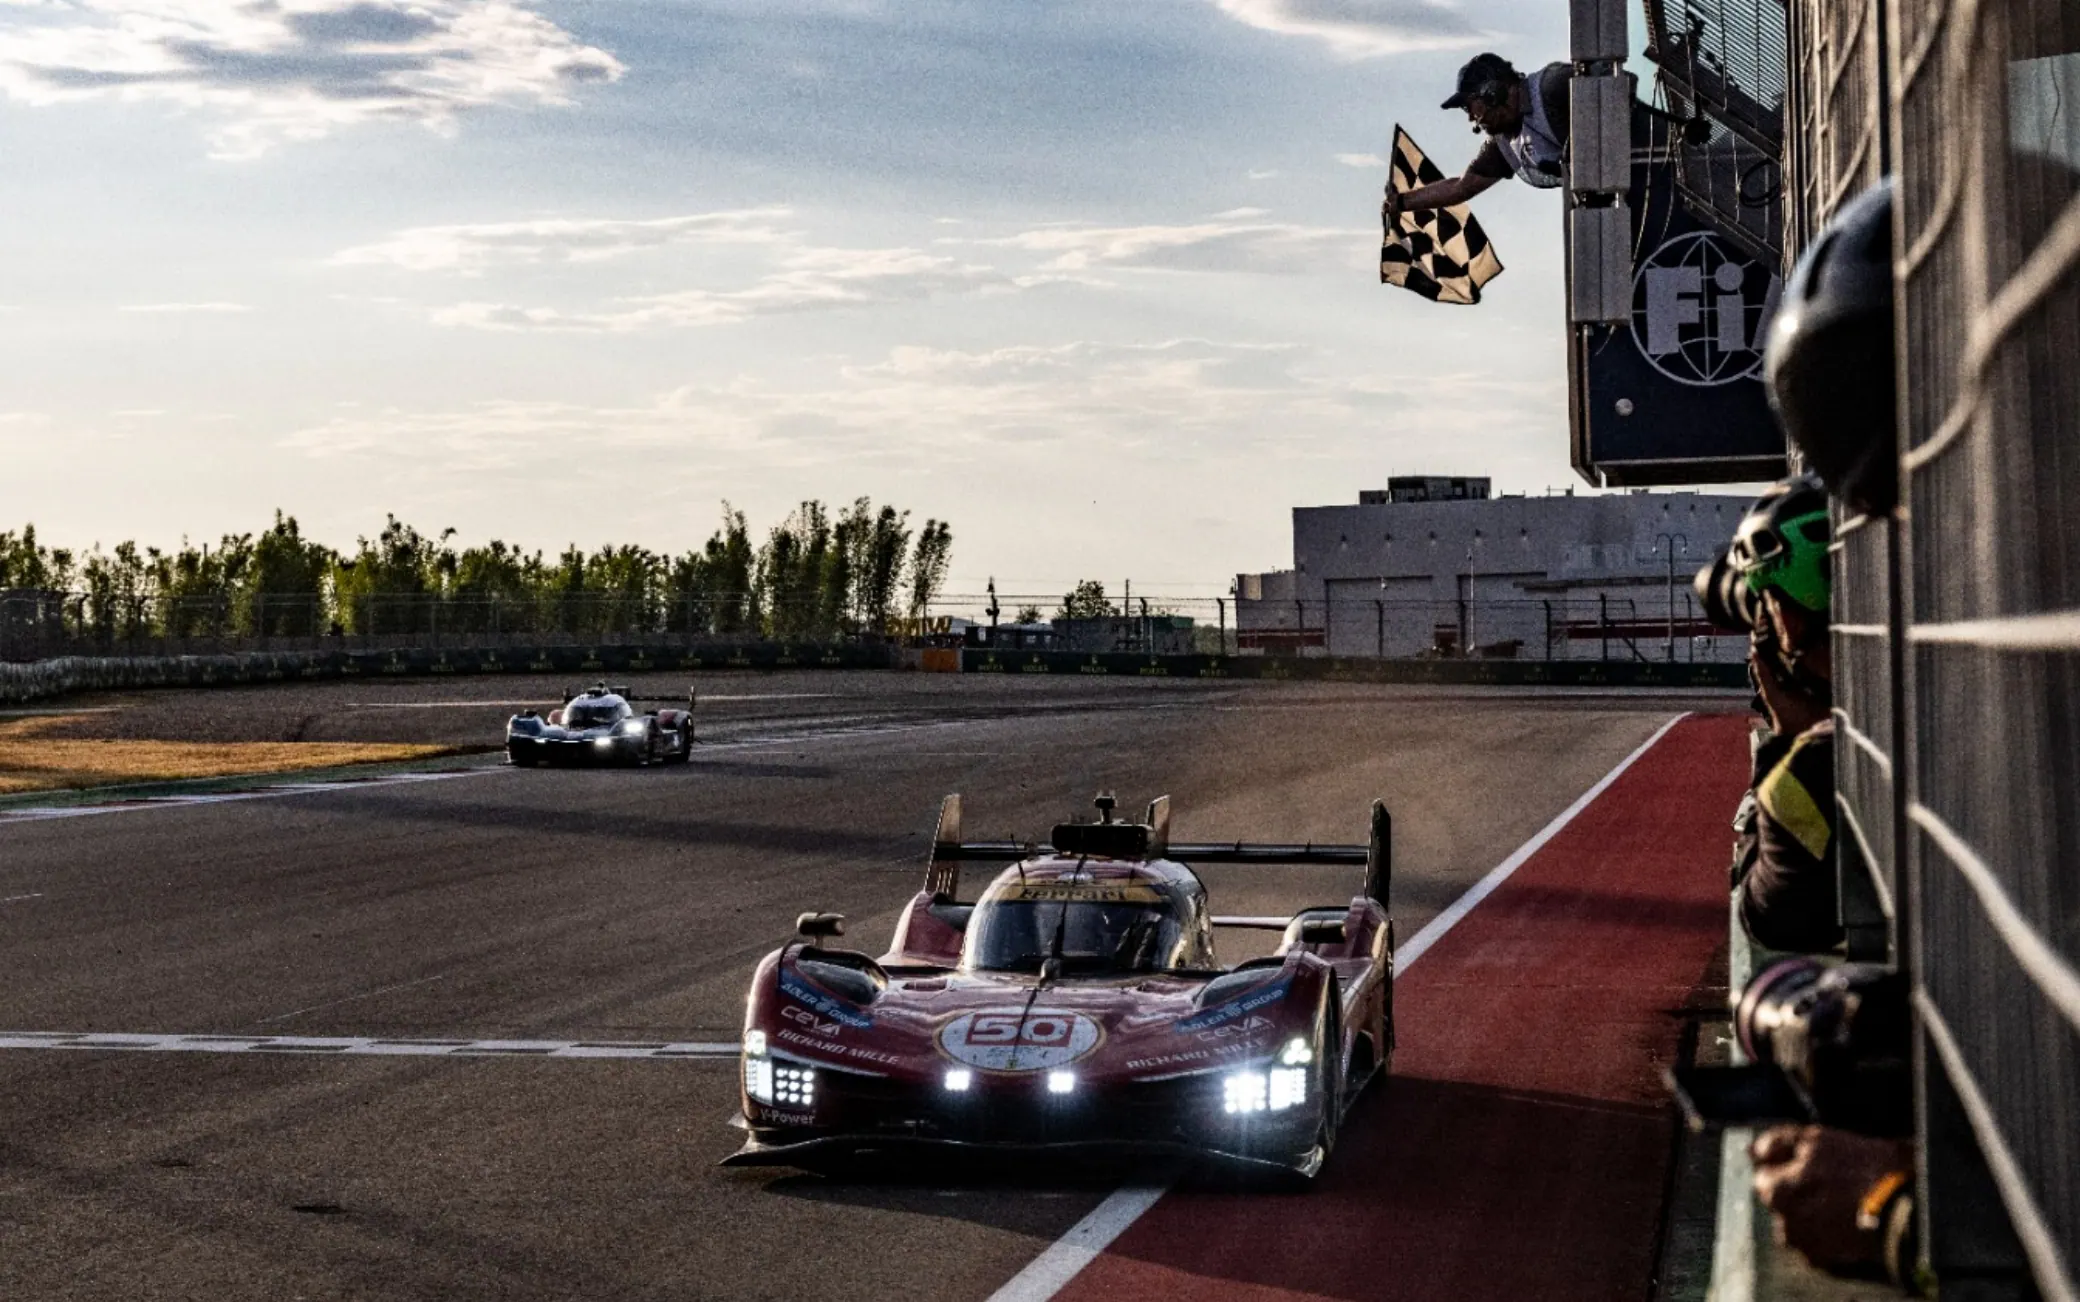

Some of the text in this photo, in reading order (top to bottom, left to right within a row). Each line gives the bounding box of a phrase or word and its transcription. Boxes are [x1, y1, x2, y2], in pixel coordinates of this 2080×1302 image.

[970, 1016, 1069, 1043] 50
[777, 1028, 848, 1055] RICHARD
[848, 1047, 901, 1066] MILLE
[1125, 1049, 1210, 1069] RICHARD
